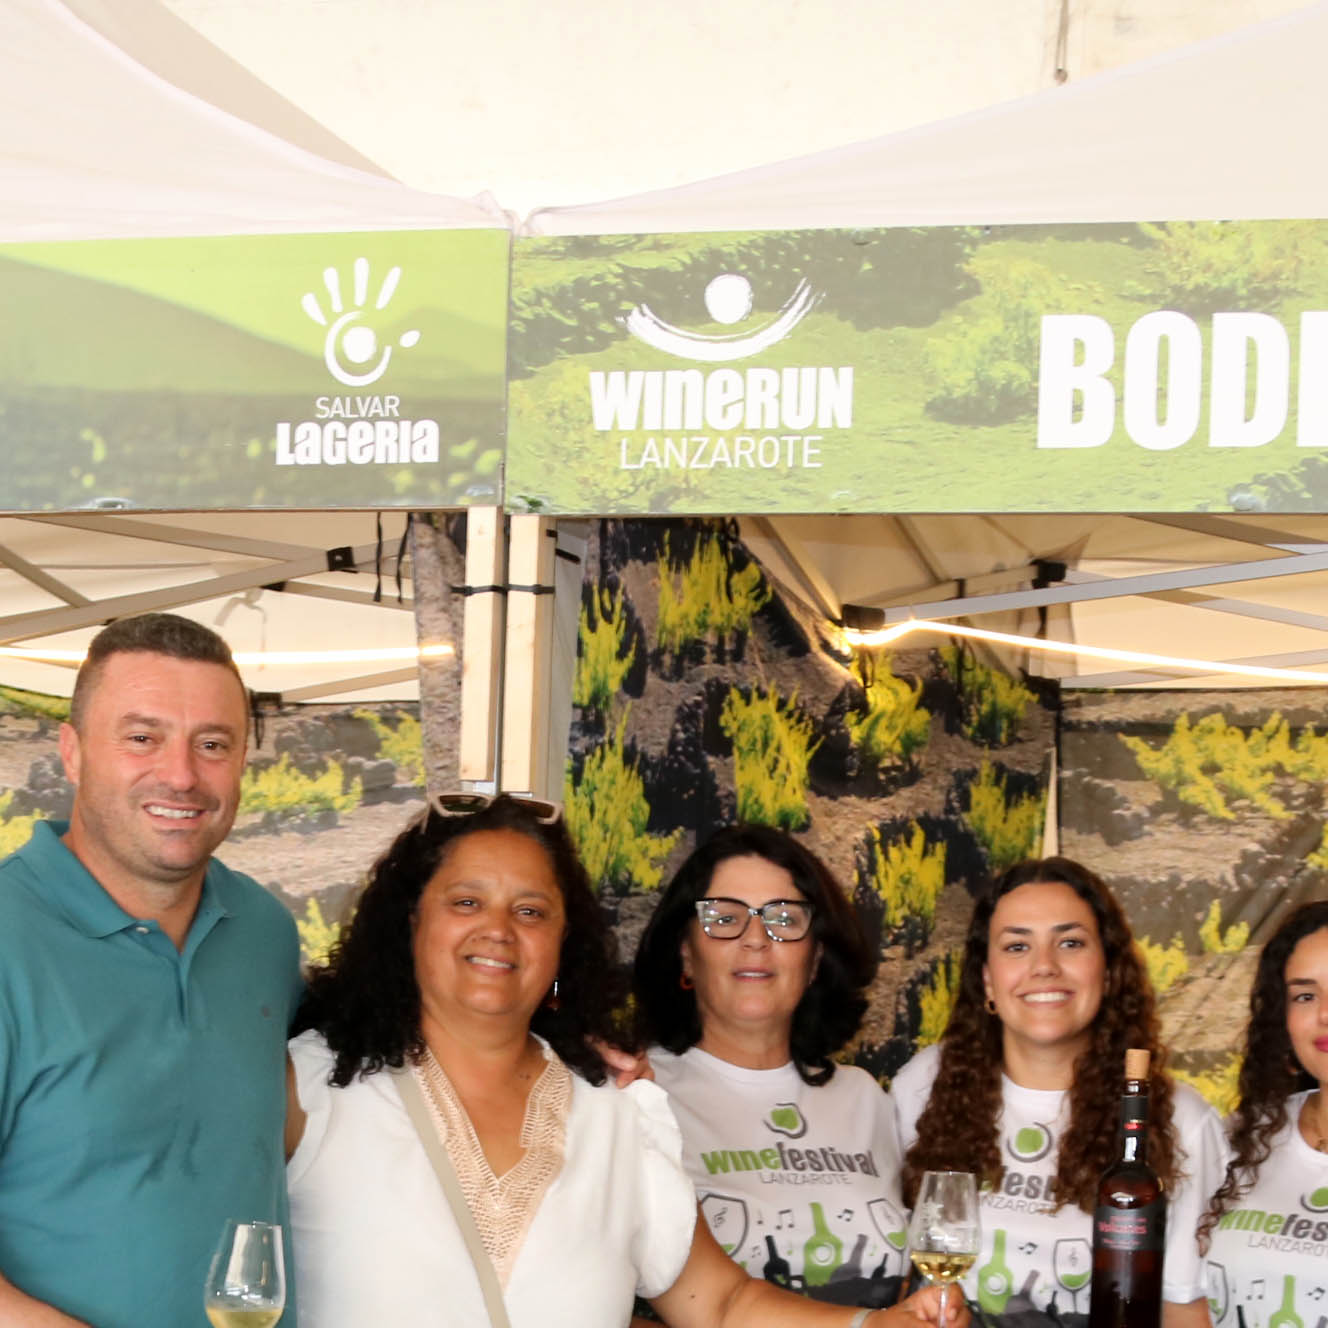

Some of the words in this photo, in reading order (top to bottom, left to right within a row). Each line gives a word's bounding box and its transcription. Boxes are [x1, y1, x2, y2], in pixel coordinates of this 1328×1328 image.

[315, 395, 400, 418] SALVAR
[620, 435, 823, 469] LANZAROTE
[758, 1172, 853, 1185] LANZAROTE
